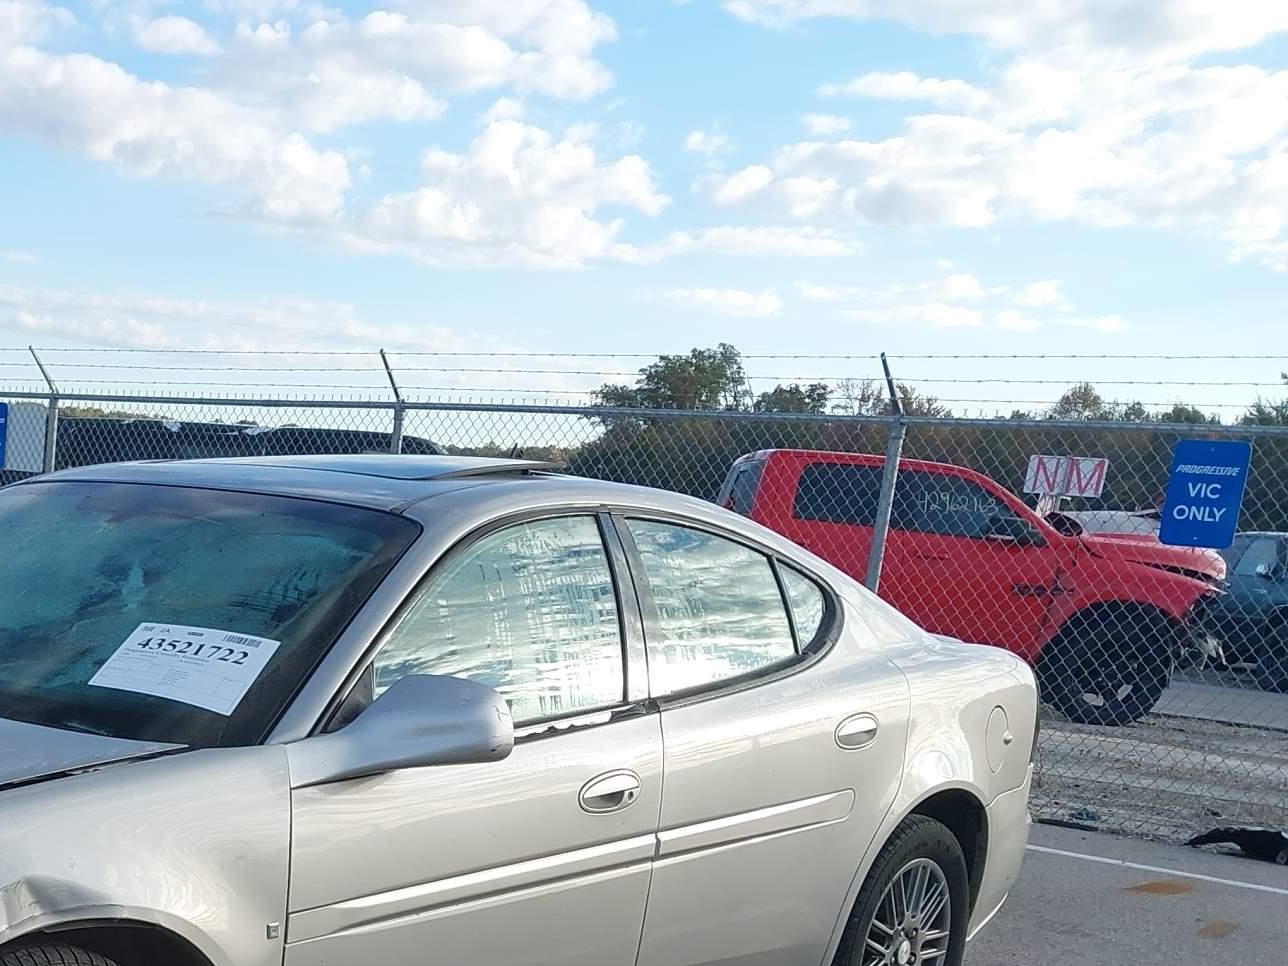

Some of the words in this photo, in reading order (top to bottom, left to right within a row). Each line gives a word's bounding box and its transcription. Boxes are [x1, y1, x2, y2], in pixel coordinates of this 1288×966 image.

[1031, 456, 1106, 496] NM
[1175, 464, 1241, 477] PROGRESSIVE
[1187, 482, 1222, 499] VIC
[1172, 504, 1227, 523] ONLY
[136, 636, 250, 666] 43521722
